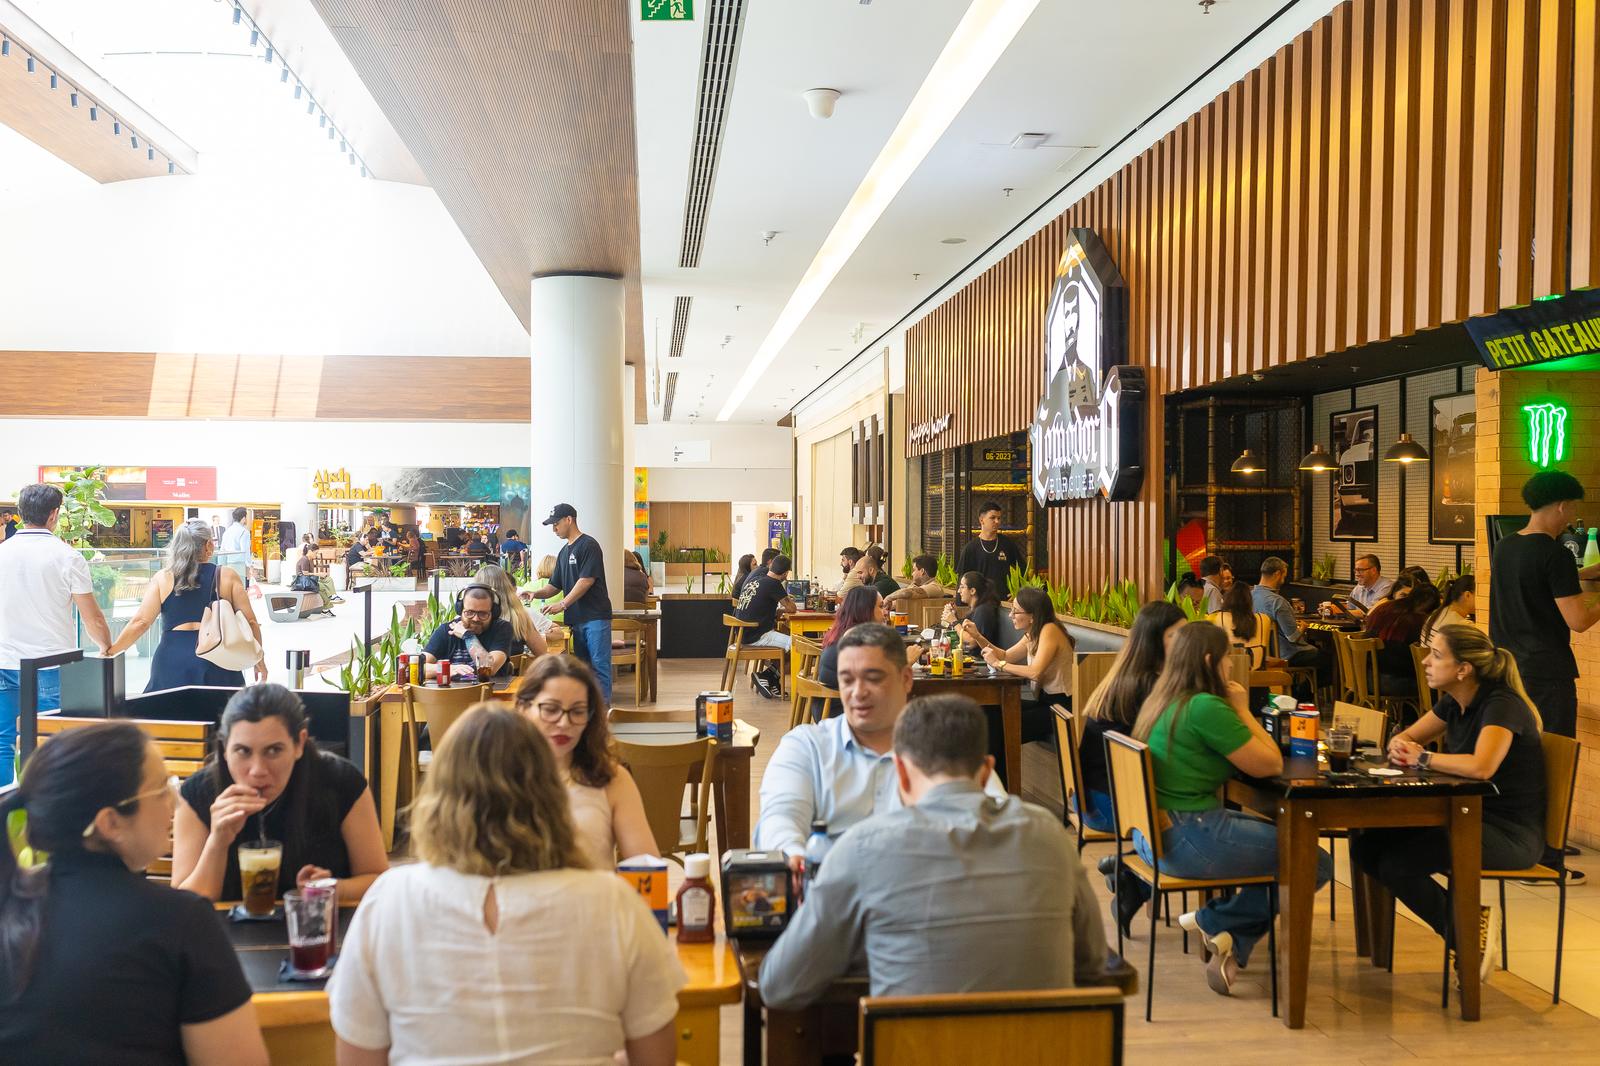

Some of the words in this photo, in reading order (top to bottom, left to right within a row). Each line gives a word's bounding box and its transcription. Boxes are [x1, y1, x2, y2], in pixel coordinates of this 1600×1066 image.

[1485, 334, 1535, 368] PETIT
[1530, 317, 1600, 358] GATEAU
[313, 467, 349, 483] Aish
[312, 482, 383, 500] Baladi
